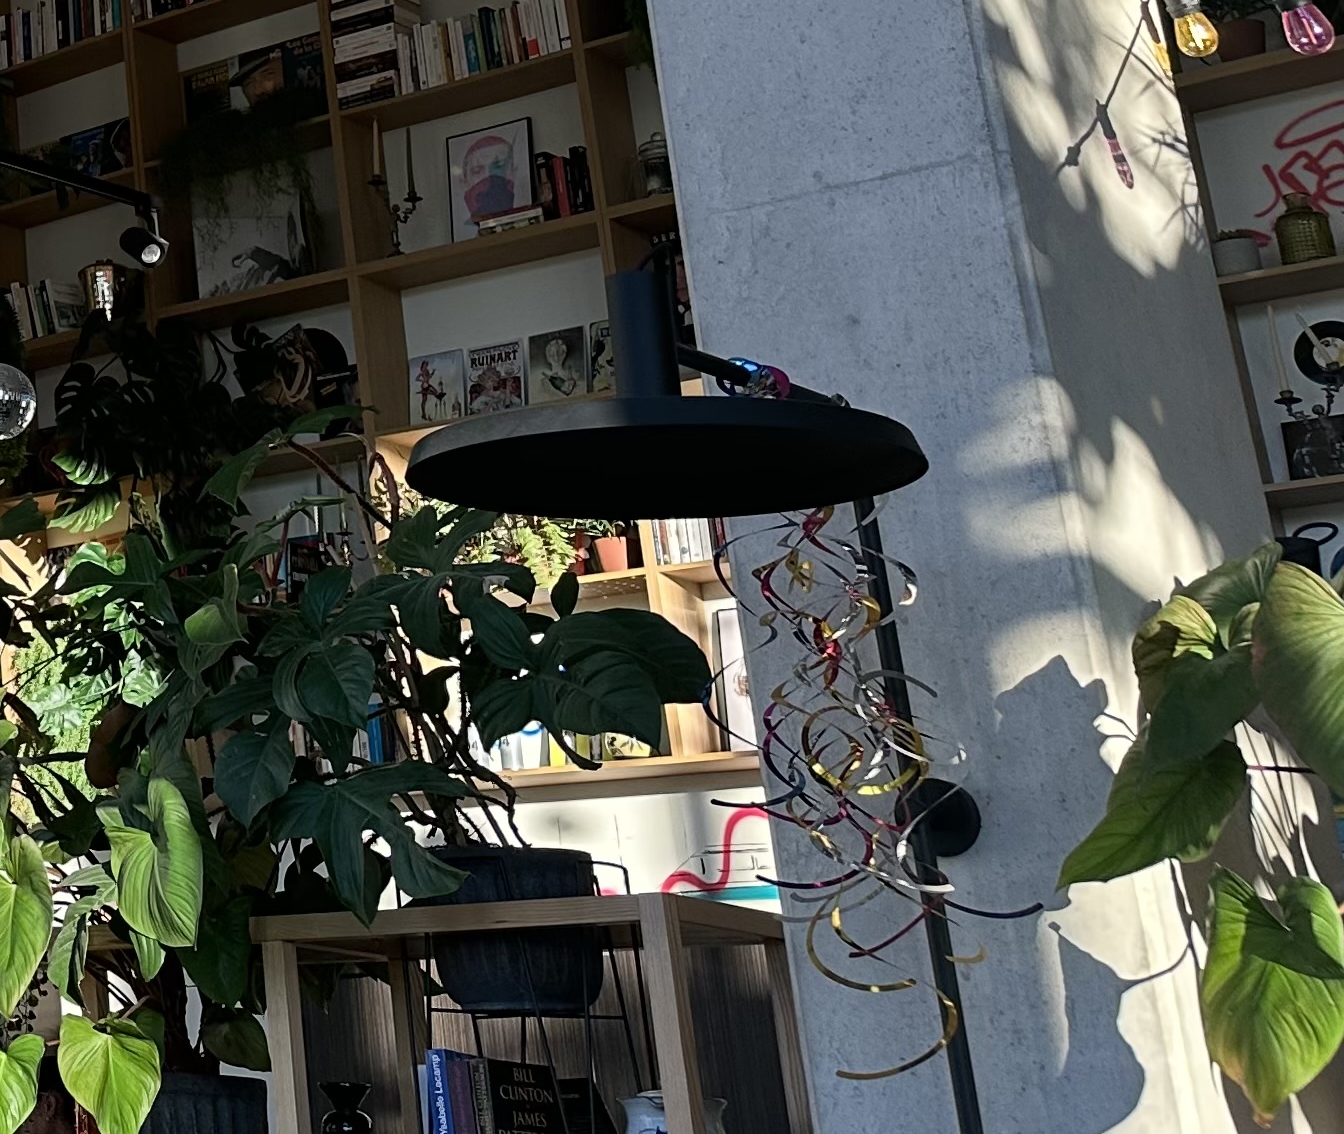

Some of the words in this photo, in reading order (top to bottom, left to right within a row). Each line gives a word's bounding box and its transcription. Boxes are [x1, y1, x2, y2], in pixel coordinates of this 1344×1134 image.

[470, 349, 518, 368] RUINART
[513, 1067, 536, 1083] BILL
[499, 1084, 554, 1104] CLINTON
[513, 1110, 548, 1129] JAMES
